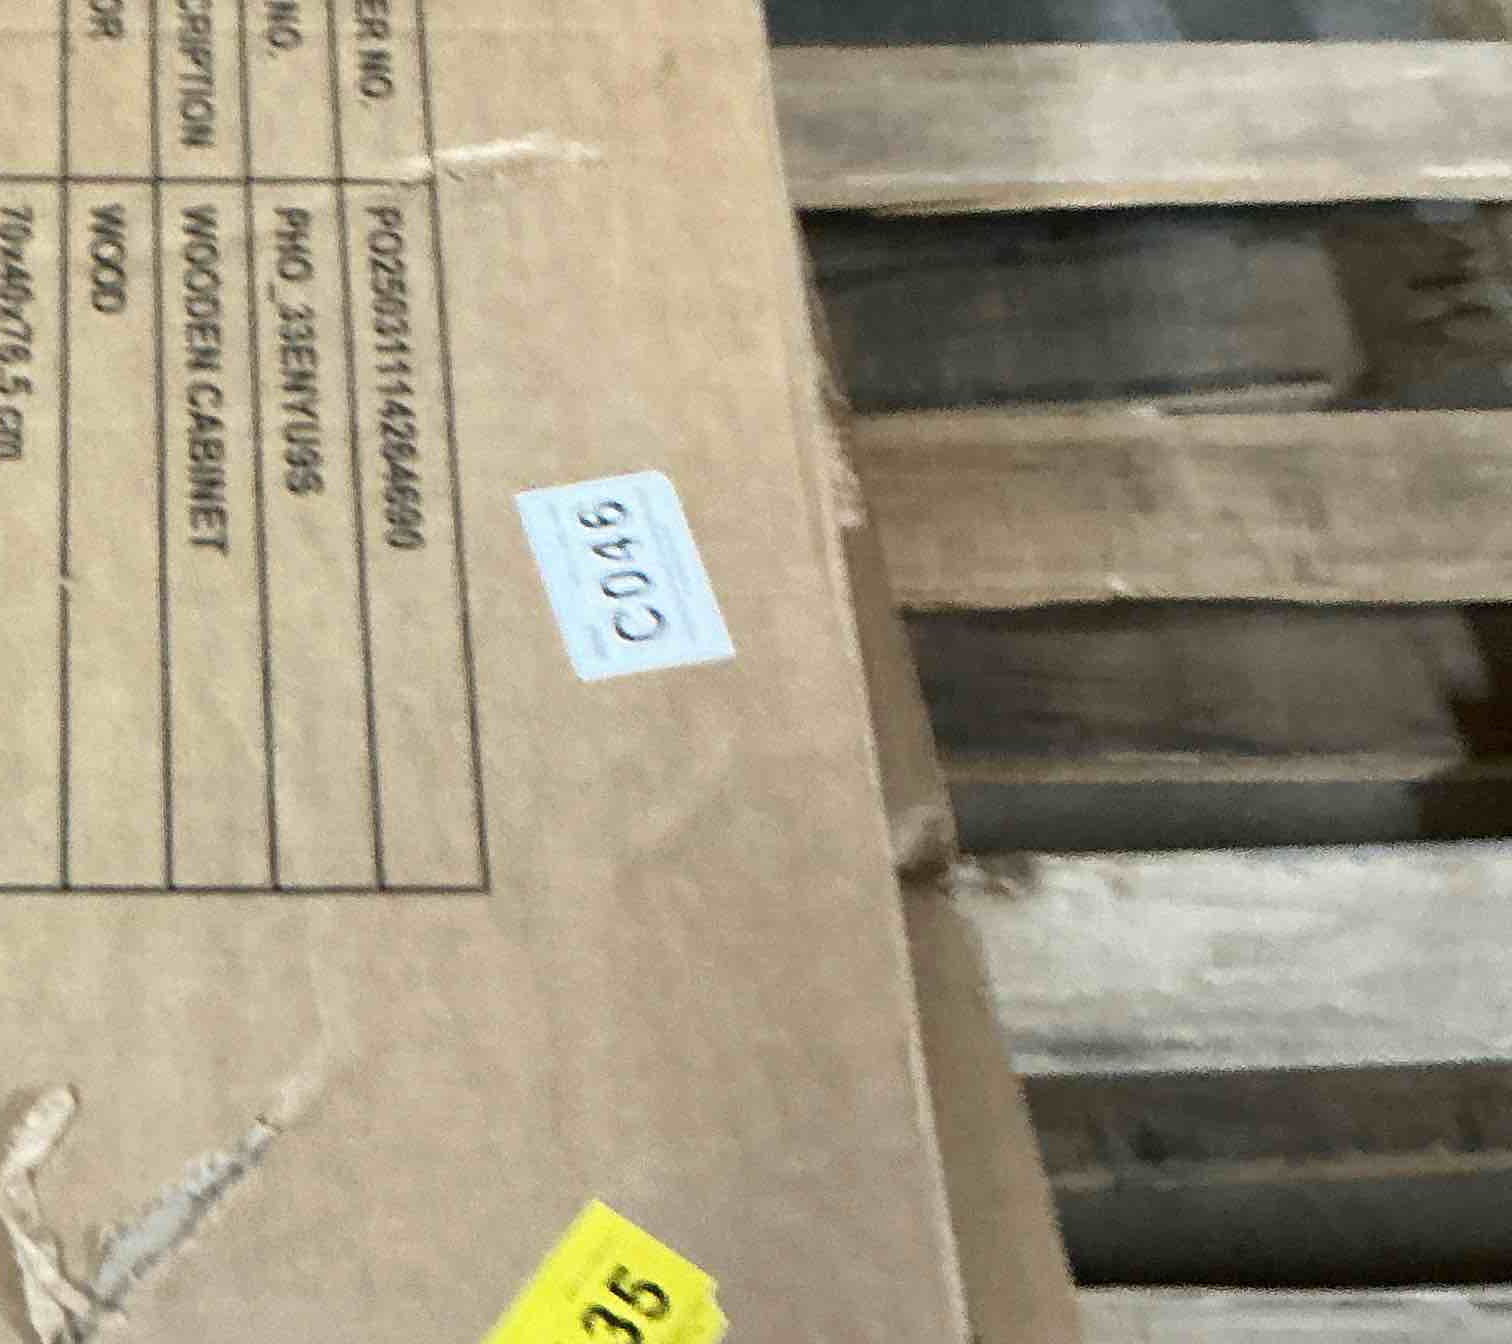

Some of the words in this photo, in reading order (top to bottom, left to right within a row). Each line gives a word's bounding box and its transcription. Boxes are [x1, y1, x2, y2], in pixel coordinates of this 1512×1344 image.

[265, 0, 302, 58] NO.
[356, 48, 392, 107] NO.
[90, 206, 125, 314] WOOD
[182, 206, 220, 372] WOODEN
[187, 382, 227, 555] CABINET
[577, 500, 668, 642] C046
